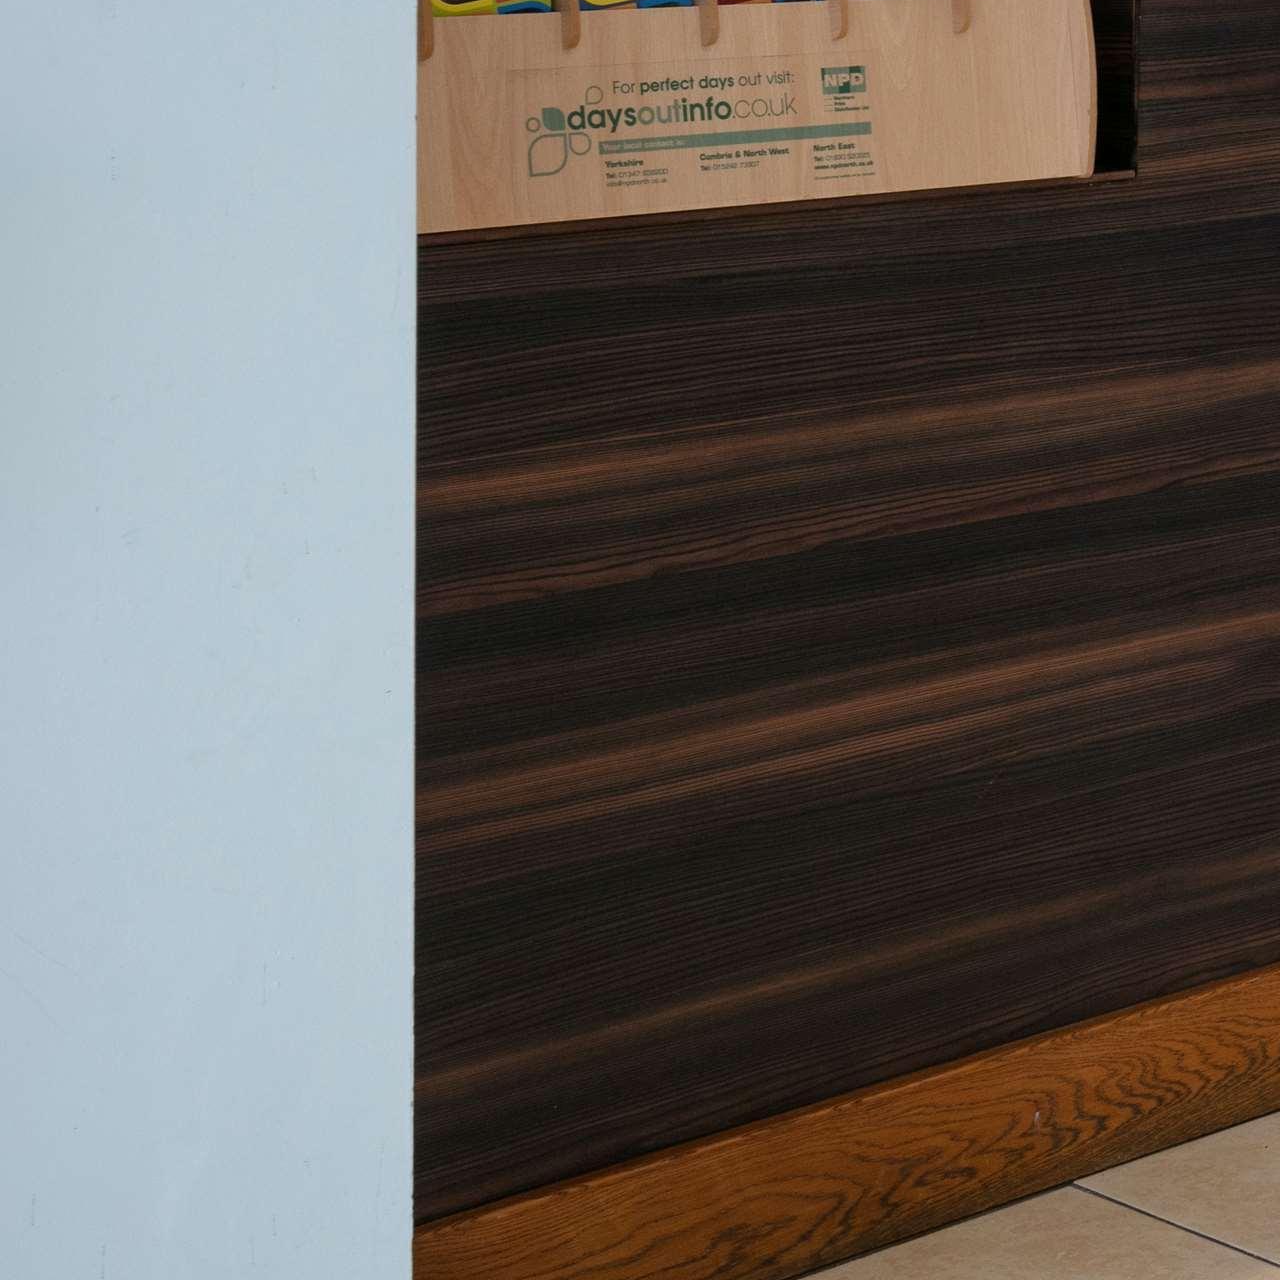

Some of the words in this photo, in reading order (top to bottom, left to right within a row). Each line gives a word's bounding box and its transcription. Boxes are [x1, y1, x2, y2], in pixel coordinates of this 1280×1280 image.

[612, 80, 636, 95] For
[639, 75, 694, 96] perfect
[698, 75, 735, 91] days
[738, 71, 762, 87] out
[765, 70, 795, 85] visit:
[822, 73, 866, 89] NPD
[566, 92, 798, 134] daysoutinfo.co.uk
[699, 151, 733, 161] Cumbria
[734, 150, 742, 160] &
[743, 149, 768, 158] North
[768, 147, 790, 157] West
[813, 144, 836, 153] North
[837, 142, 856, 151] East
[604, 159, 645, 169] Yorkshire
